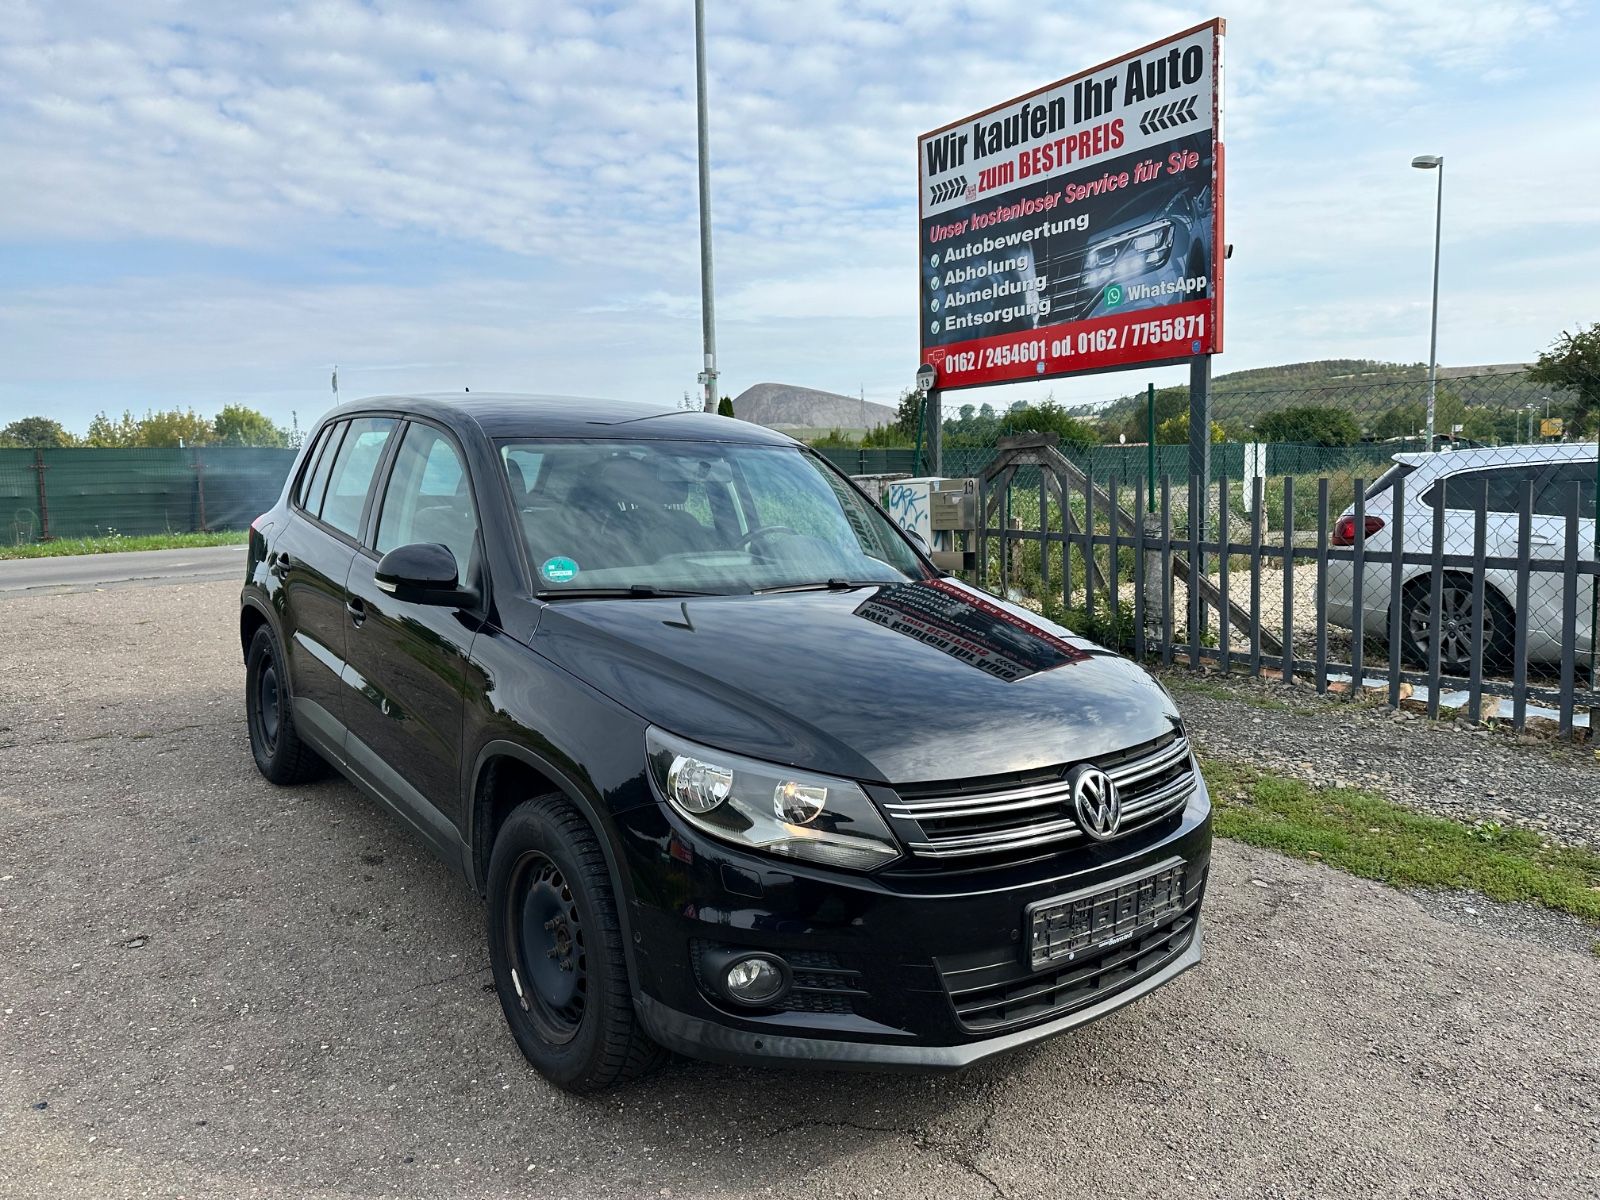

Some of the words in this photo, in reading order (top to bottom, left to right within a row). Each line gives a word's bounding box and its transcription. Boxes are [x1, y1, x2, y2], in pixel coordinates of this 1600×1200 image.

[927, 133, 968, 177] Wir
[973, 94, 1066, 160] kaufen
[1073, 75, 1117, 125] Ihr
[1123, 44, 1204, 108] Auto
[978, 160, 1014, 192] zum
[1019, 118, 1125, 180] BESTPREIS
[930, 218, 969, 244] Unser
[971, 191, 1062, 231] kostenloser
[1064, 170, 1129, 206] Service
[1133, 159, 1162, 185] für
[1167, 149, 1200, 175] Sie
[944, 212, 1090, 265] Autobewertung
[944, 254, 1029, 288] Abholung
[944, 275, 1047, 310] Abmeldung
[1127, 275, 1208, 302] WhatsApp
[945, 298, 1052, 332] Entsorgung
[945, 353, 975, 374] 0162
[986, 340, 1046, 367] 2454601
[1051, 335, 1075, 359] od.
[1078, 328, 1117, 355] 0162
[1131, 314, 1205, 346] 7755871
[964, 480, 974, 495] 19
